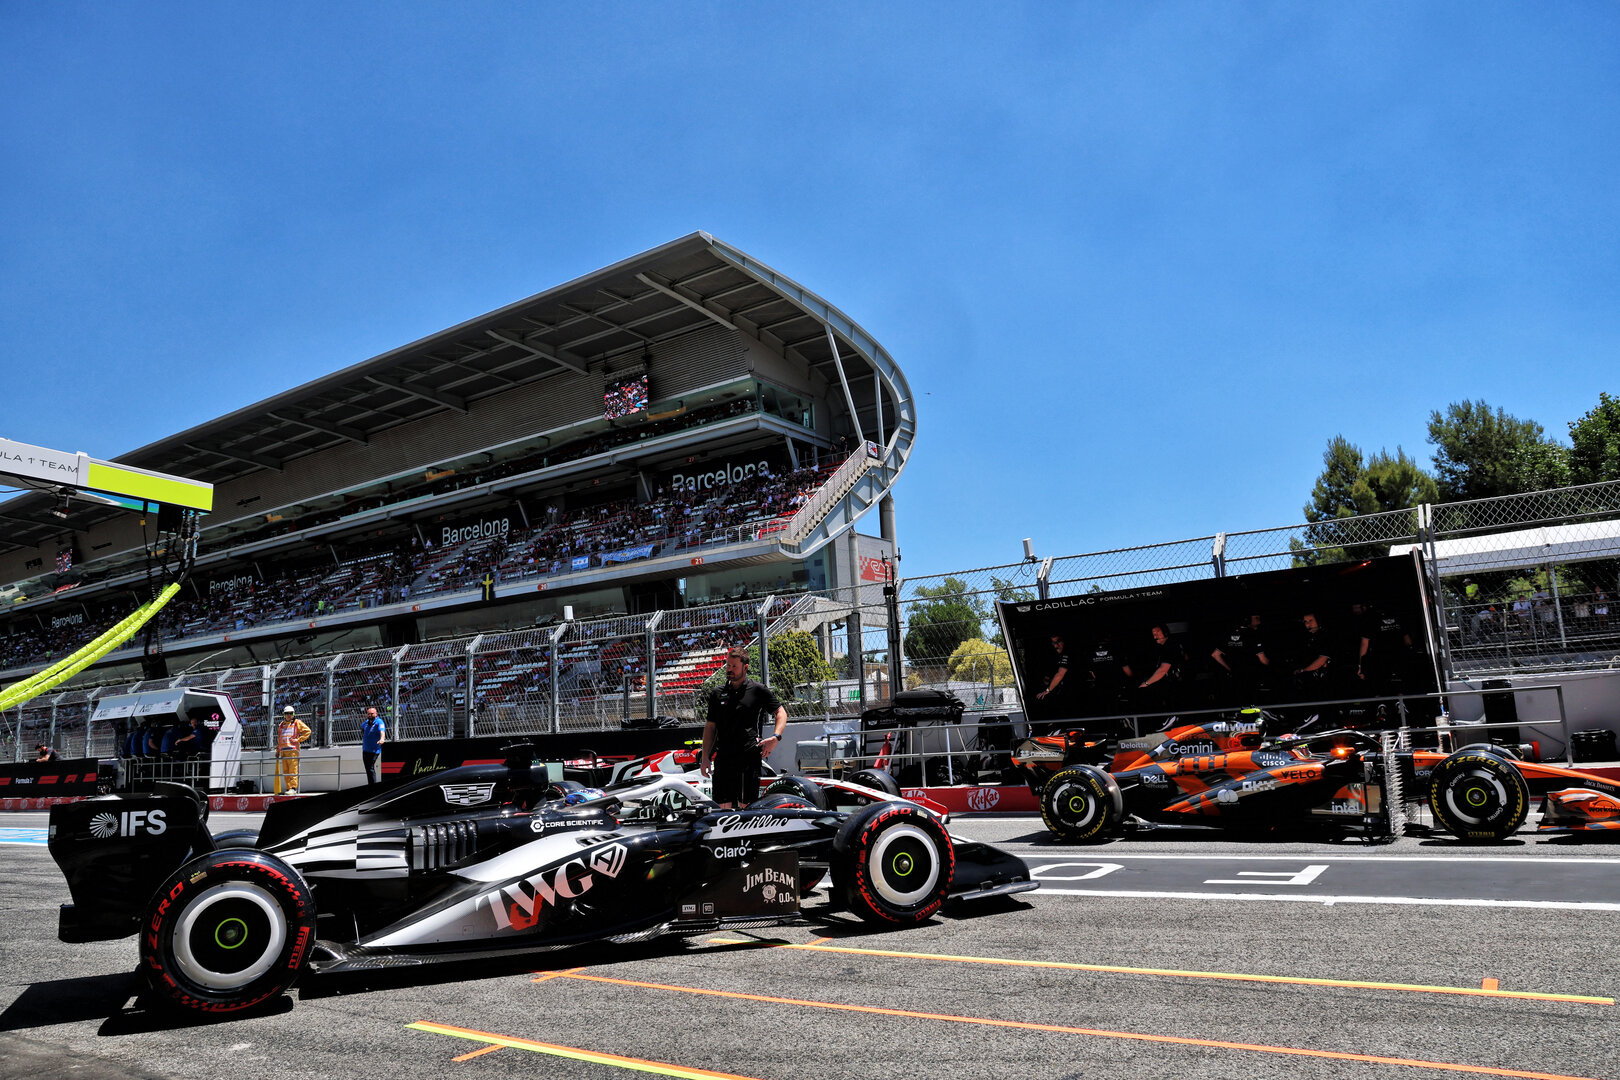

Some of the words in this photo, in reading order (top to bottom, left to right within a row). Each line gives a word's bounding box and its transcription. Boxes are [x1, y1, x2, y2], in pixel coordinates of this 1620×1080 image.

[40, 459, 79, 474] TEAM
[672, 460, 769, 491] Barcelona
[442, 518, 509, 545] Barcelona
[1035, 597, 1096, 611] CADILLAC
[1099, 593, 1134, 602] FORMULA
[1142, 590, 1163, 598] TEAM
[1168, 742, 1213, 755] Gemini
[1456, 755, 1499, 767] ZERO
[1143, 775, 1169, 784] DELL
[1281, 769, 1317, 780] VELO
[1449, 772, 1466, 787] Gemini
[971, 789, 999, 810] KitKat
[1331, 802, 1361, 815] intel
[120, 809, 167, 838] IFS
[716, 813, 789, 834] Cadillac
[861, 831, 868, 846] P
[870, 807, 912, 832] ZERO
[714, 845, 747, 859] Claro
[742, 873, 764, 893] JIM
[764, 868, 795, 889] BEAM
[475, 857, 594, 931] TWG
[148, 881, 184, 950] ZERO
[287, 926, 311, 970] PIRELLI
[149, 955, 163, 970] P
